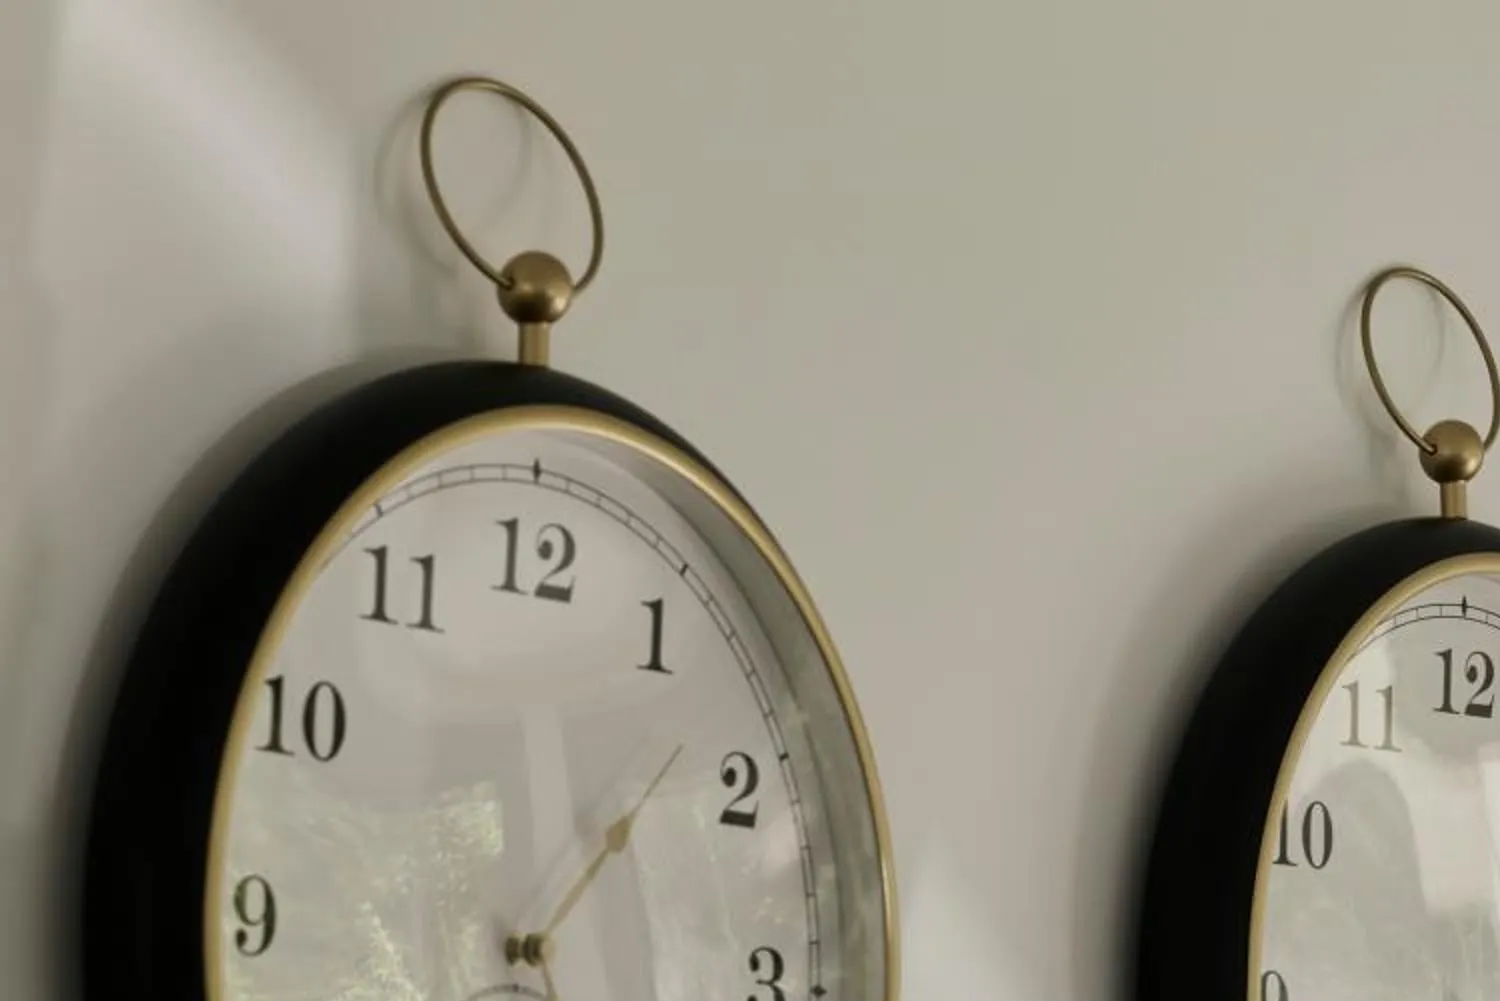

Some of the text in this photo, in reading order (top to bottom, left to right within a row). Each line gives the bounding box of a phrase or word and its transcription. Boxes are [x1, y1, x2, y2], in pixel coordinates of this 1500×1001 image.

[359, 545, 445, 634] 11
[491, 517, 577, 603] 12
[636, 597, 674, 675] 1
[254, 675, 346, 761] 10
[1340, 680, 1403, 752] 11
[1433, 648, 1496, 718] 12
[719, 751, 759, 829] 2
[1272, 800, 1333, 868] 10
[233, 875, 277, 956] 9
